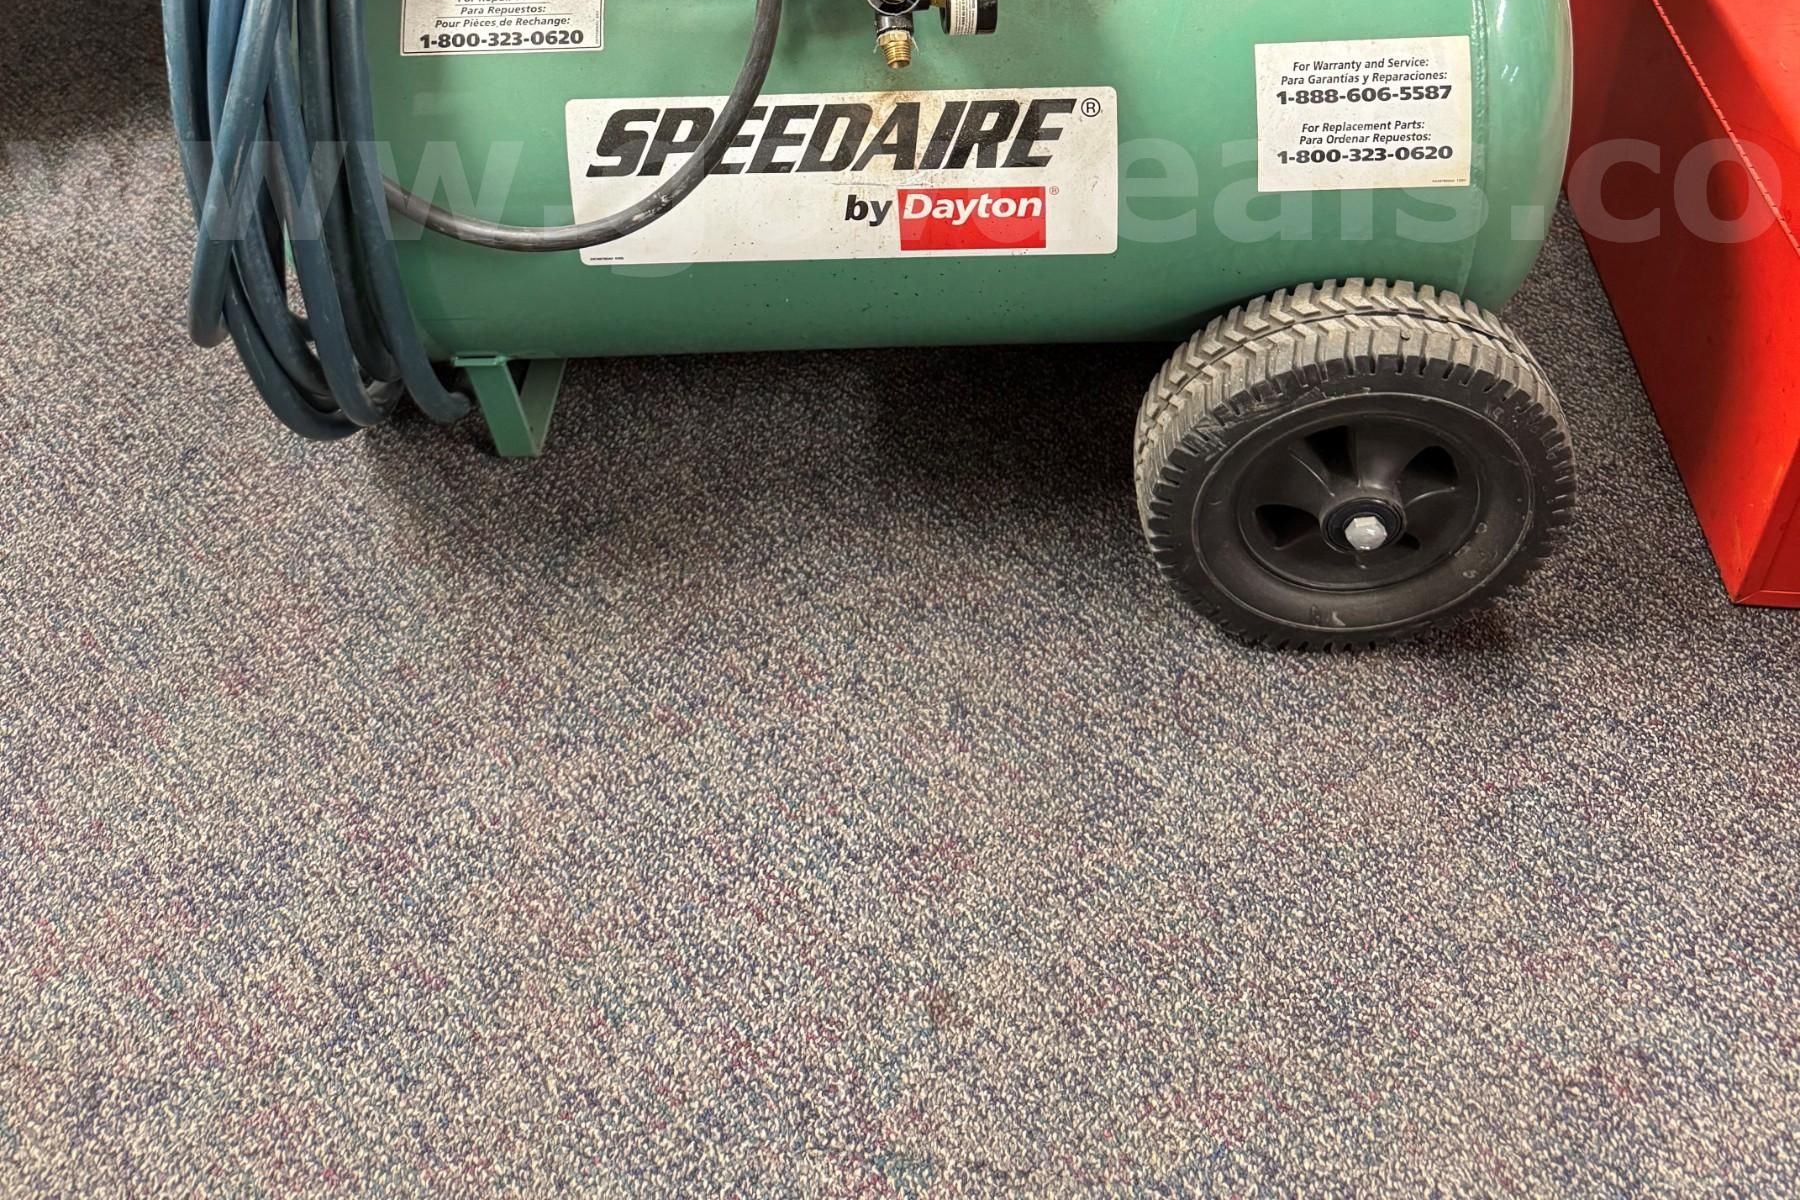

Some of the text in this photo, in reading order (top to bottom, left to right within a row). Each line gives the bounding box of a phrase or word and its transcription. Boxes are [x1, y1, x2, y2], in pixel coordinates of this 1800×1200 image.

[460, 5, 546, 16] Para Repuestos:
[435, 16, 571, 28] Pour Pièces de Rechange:
[420, 30, 584, 49] 1-800-323-0620
[1293, 56, 1429, 72] For Warranty and Service:
[1281, 71, 1448, 86] Para Garantías y Reparaciones:
[1276, 85, 1452, 105] 1-888-606-5587
[1301, 120, 1425, 134] For Replacement Parts:
[1299, 133, 1431, 145] Para Ordenar Repuestos:
[1277, 146, 1453, 164] 1-800-323-0620
[845, 194, 893, 227] by
[903, 193, 1042, 225] Dayton
